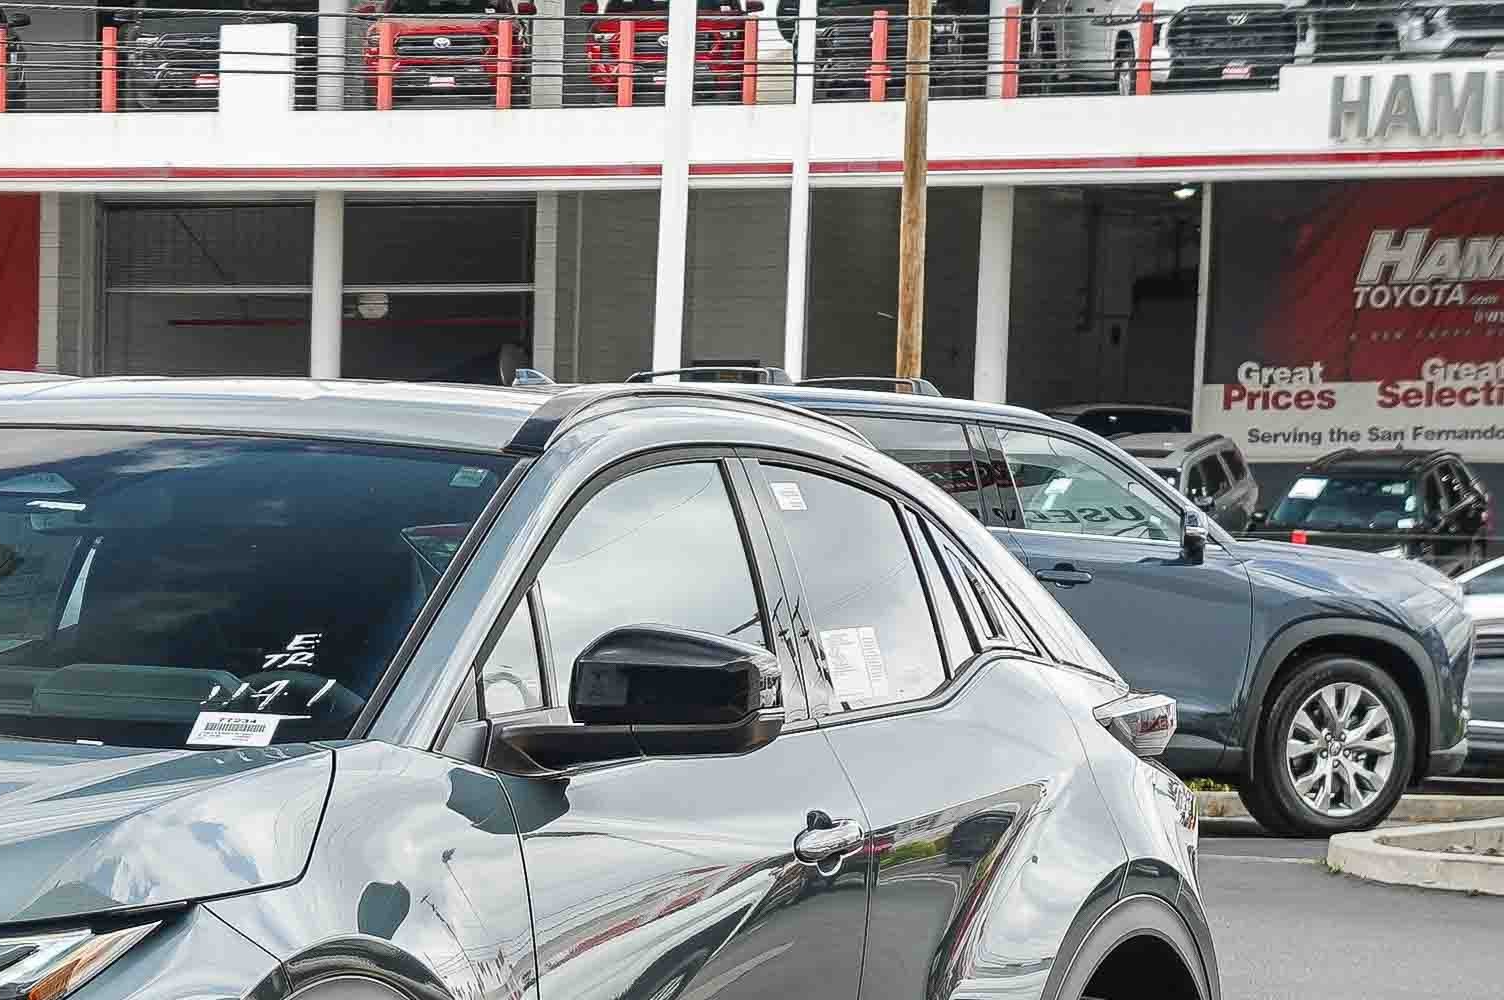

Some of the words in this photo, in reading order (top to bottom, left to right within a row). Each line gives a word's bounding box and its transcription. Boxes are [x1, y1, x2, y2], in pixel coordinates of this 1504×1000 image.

[1329, 71, 1504, 142] HAM
[1237, 360, 1326, 386] Great
[1222, 384, 1338, 411] Prices
[1246, 426, 1323, 446] Serving
[1329, 425, 1362, 443] the
[1367, 424, 1406, 443] San
